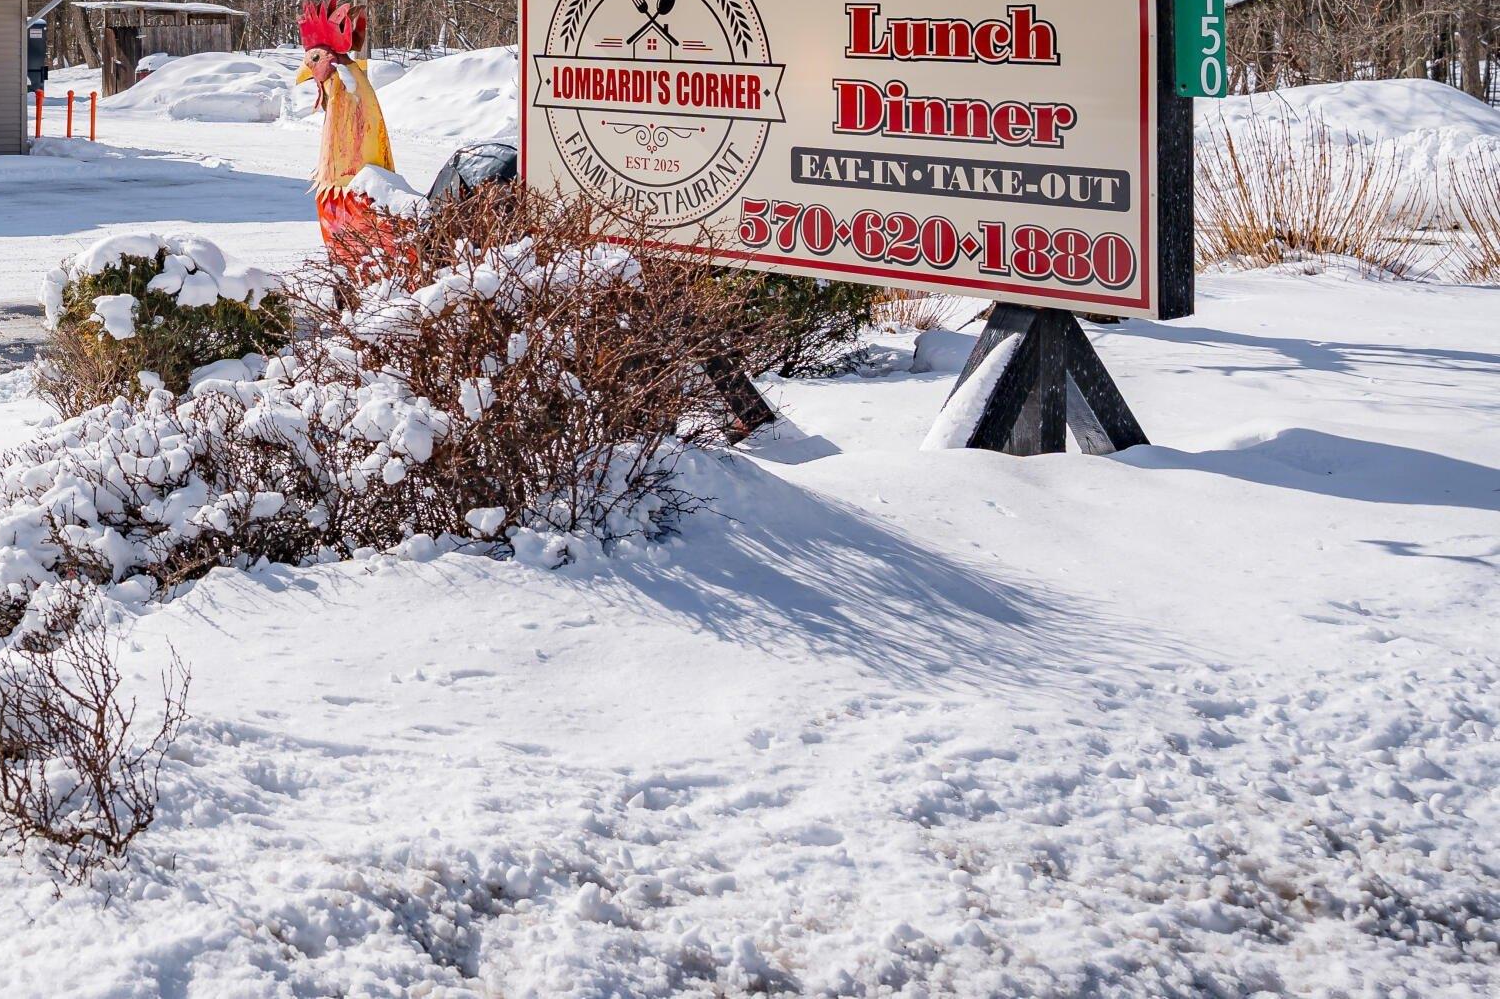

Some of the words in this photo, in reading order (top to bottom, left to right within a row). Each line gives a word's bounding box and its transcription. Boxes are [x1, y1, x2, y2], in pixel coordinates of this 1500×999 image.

[845, 3, 1061, 65] Lunch
[553, 66, 671, 106] LOMBARDI'S
[676, 71, 761, 110] CORNER
[833, 78, 1077, 149] Dinner
[565, 131, 623, 200] FAMILY
[622, 142, 744, 216] RESTAURANT
[625, 155, 651, 170] EST
[653, 158, 680, 173] 2025
